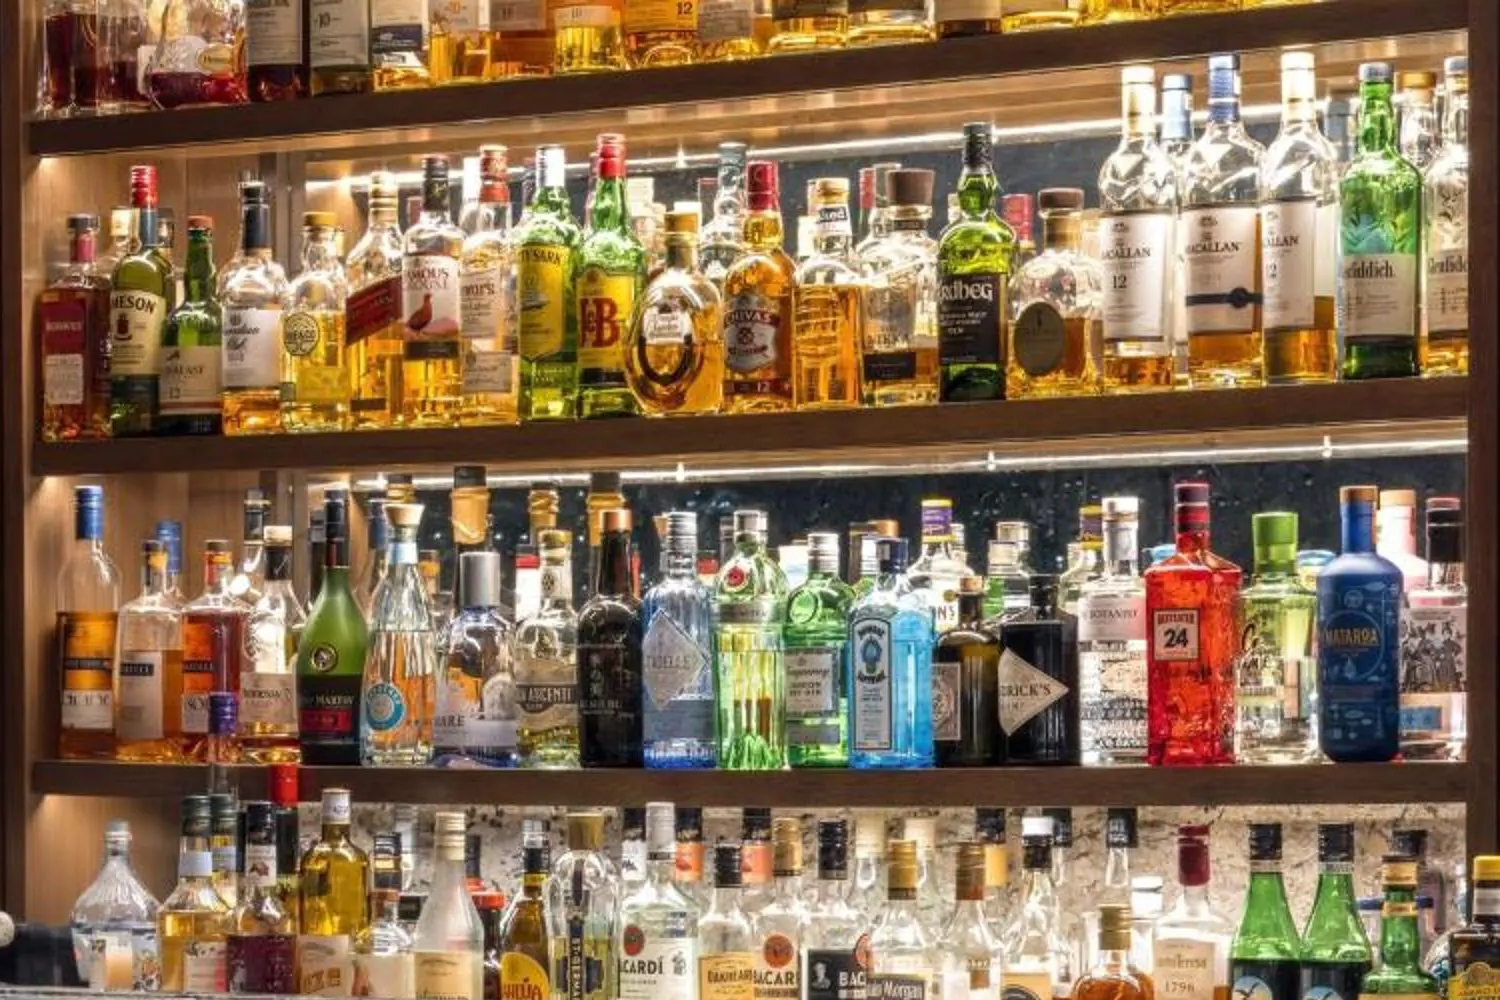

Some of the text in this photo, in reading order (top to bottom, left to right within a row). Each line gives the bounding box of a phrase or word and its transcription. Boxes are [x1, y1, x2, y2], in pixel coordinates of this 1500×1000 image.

[676, 1, 693, 16] 12
[1112, 274, 1127, 290] 12
[1163, 627, 1188, 648] 24
[838, 971, 866, 987] BAC
[884, 981, 922, 1000] Morgan
